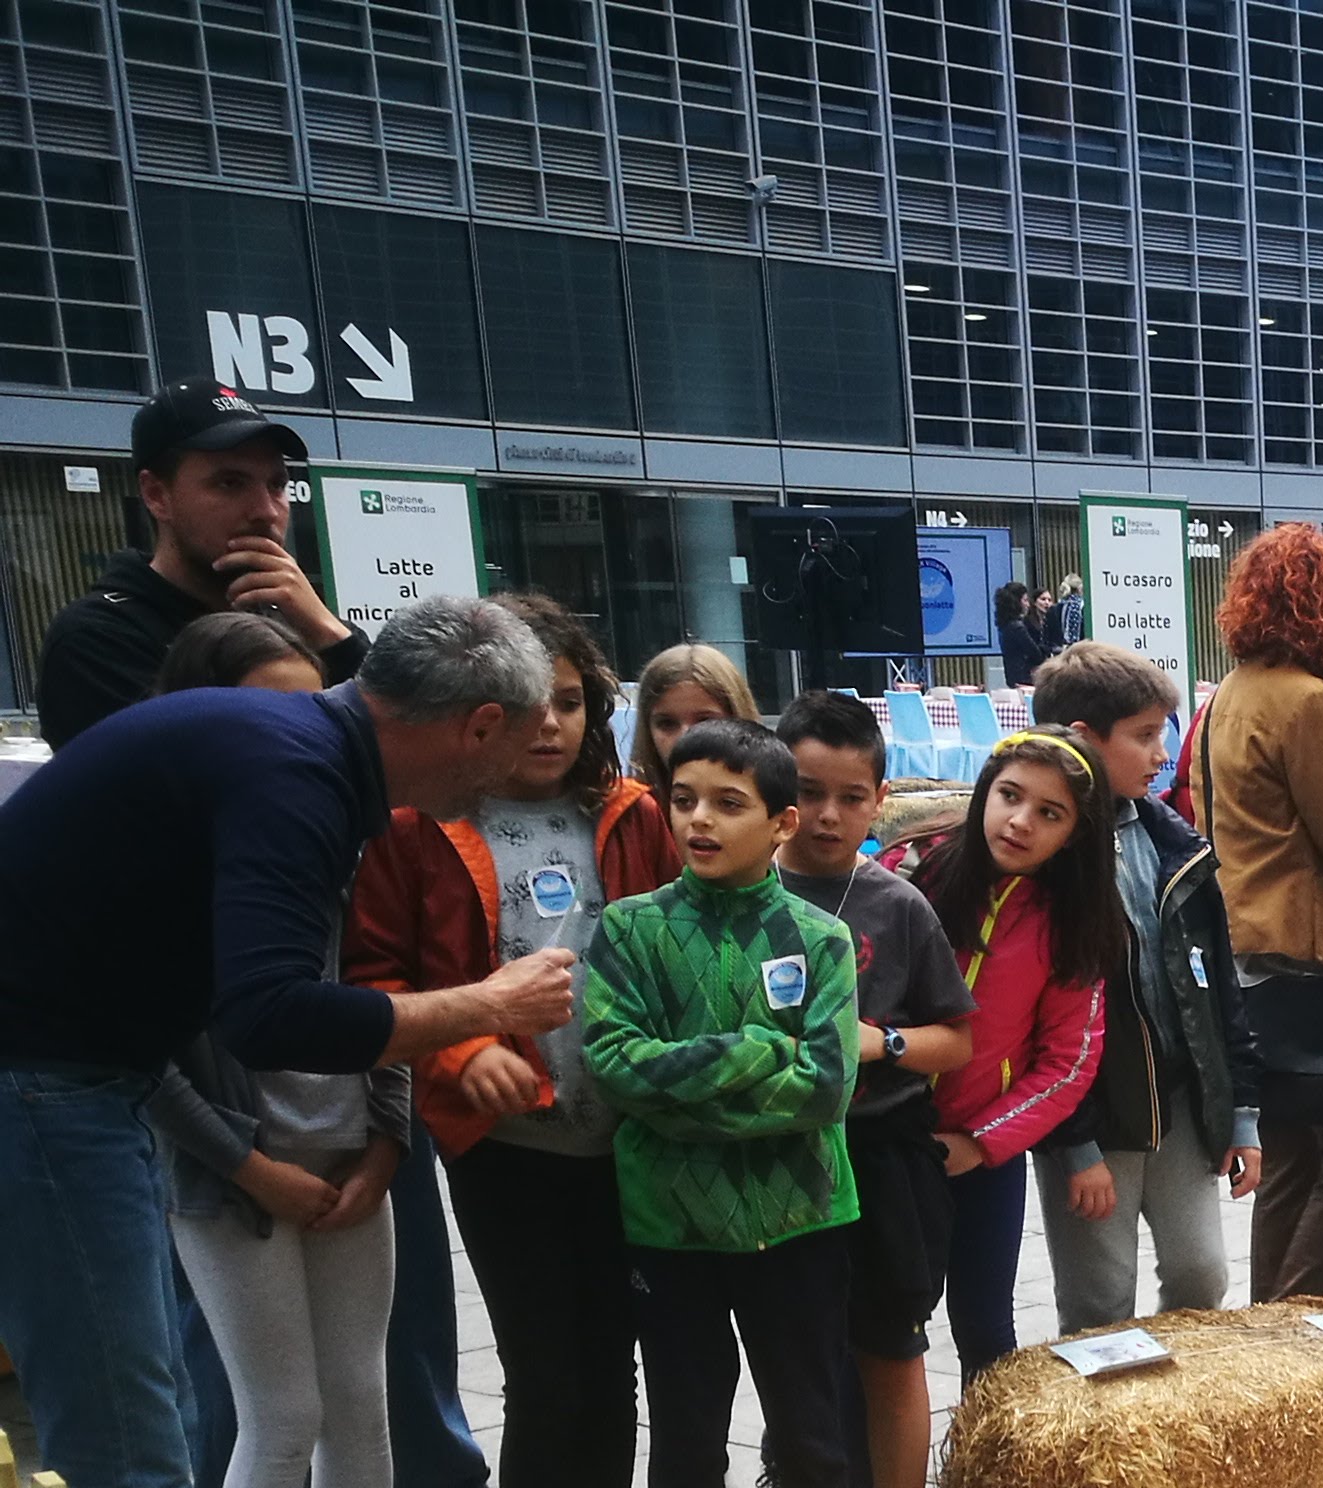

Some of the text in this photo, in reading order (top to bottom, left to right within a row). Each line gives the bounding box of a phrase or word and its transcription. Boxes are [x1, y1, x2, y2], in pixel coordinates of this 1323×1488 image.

[206, 310, 315, 394] N3
[384, 494, 424, 505] Regione
[385, 504, 437, 514] Lombardia
[925, 510, 948, 528] N4
[376, 558, 434, 576] Latte
[1102, 571, 1173, 588] Tu casaro
[399, 582, 418, 599] al
[1107, 613, 1171, 629] Dal latte
[1134, 634, 1148, 649] al
